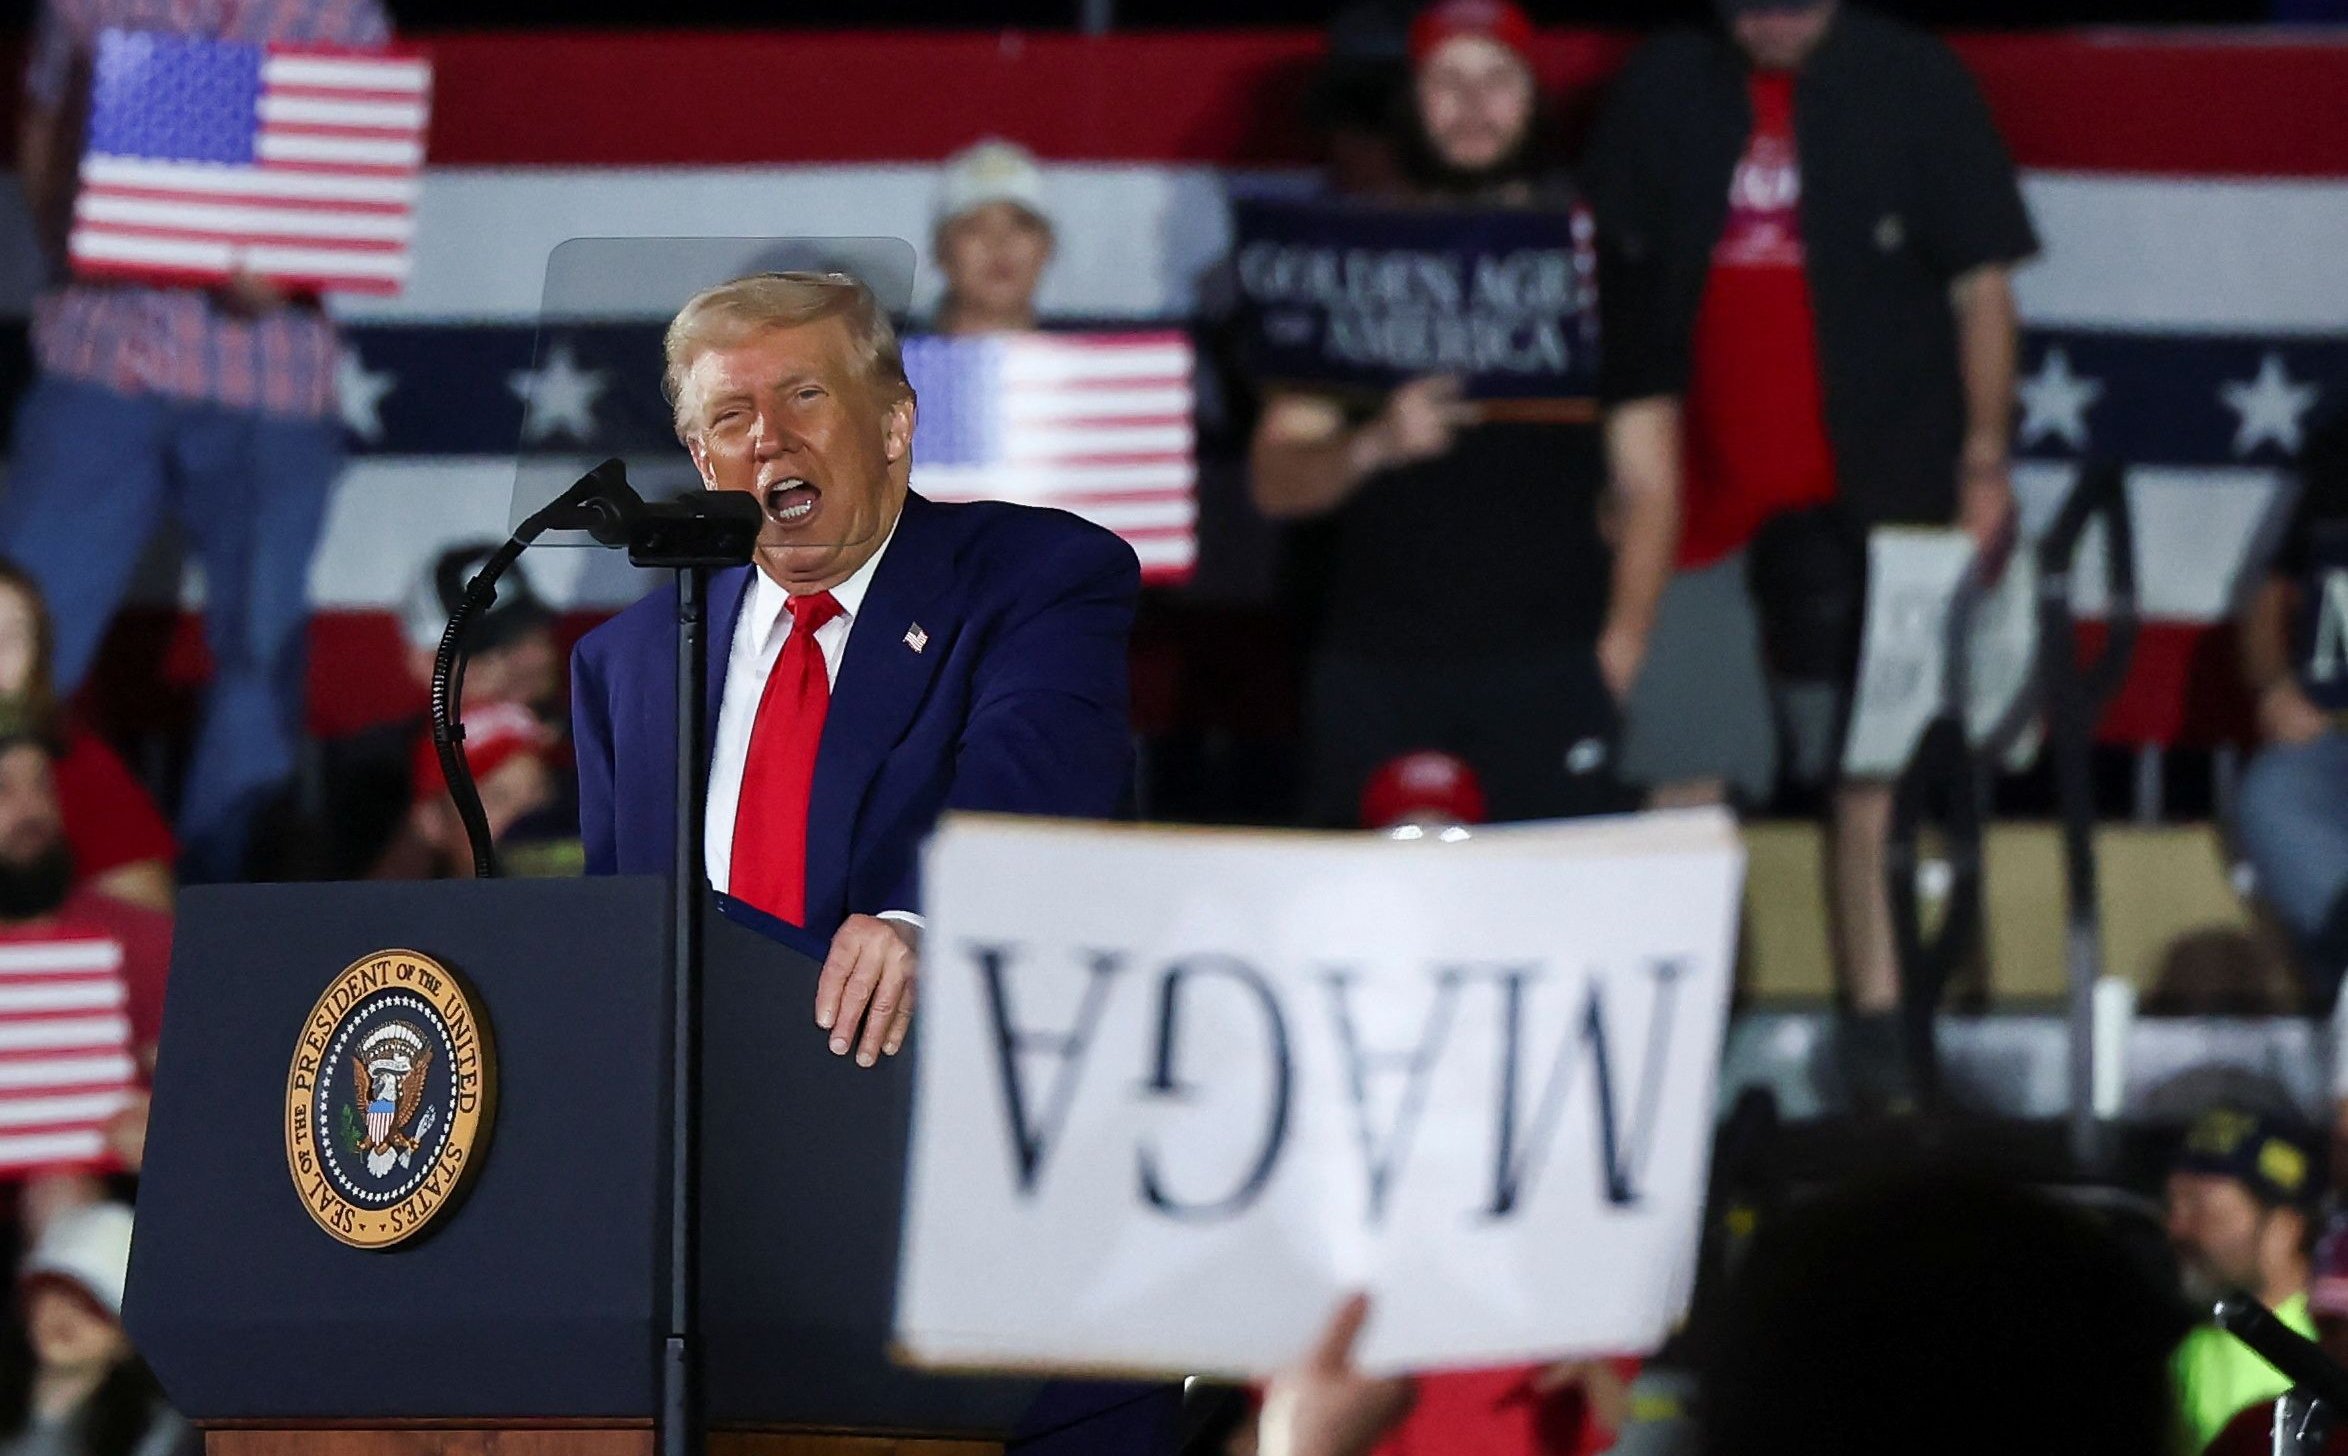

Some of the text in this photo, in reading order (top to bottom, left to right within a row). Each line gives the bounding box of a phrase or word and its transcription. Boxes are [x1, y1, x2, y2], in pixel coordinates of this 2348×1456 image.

[1239, 241, 1572, 312] GOLDEN AGE
[1326, 306, 1568, 372] AMERICA
[396, 963, 416, 981] OF
[419, 968, 442, 997] THE
[295, 961, 391, 1092] PRESIDENT
[443, 992, 477, 1113] UNITED
[958, 940, 1697, 1228] MAGA
[294, 1104, 307, 1145] THE
[298, 1150, 312, 1174] OF
[391, 1142, 462, 1233] STATES
[309, 1171, 356, 1233] SEAL
